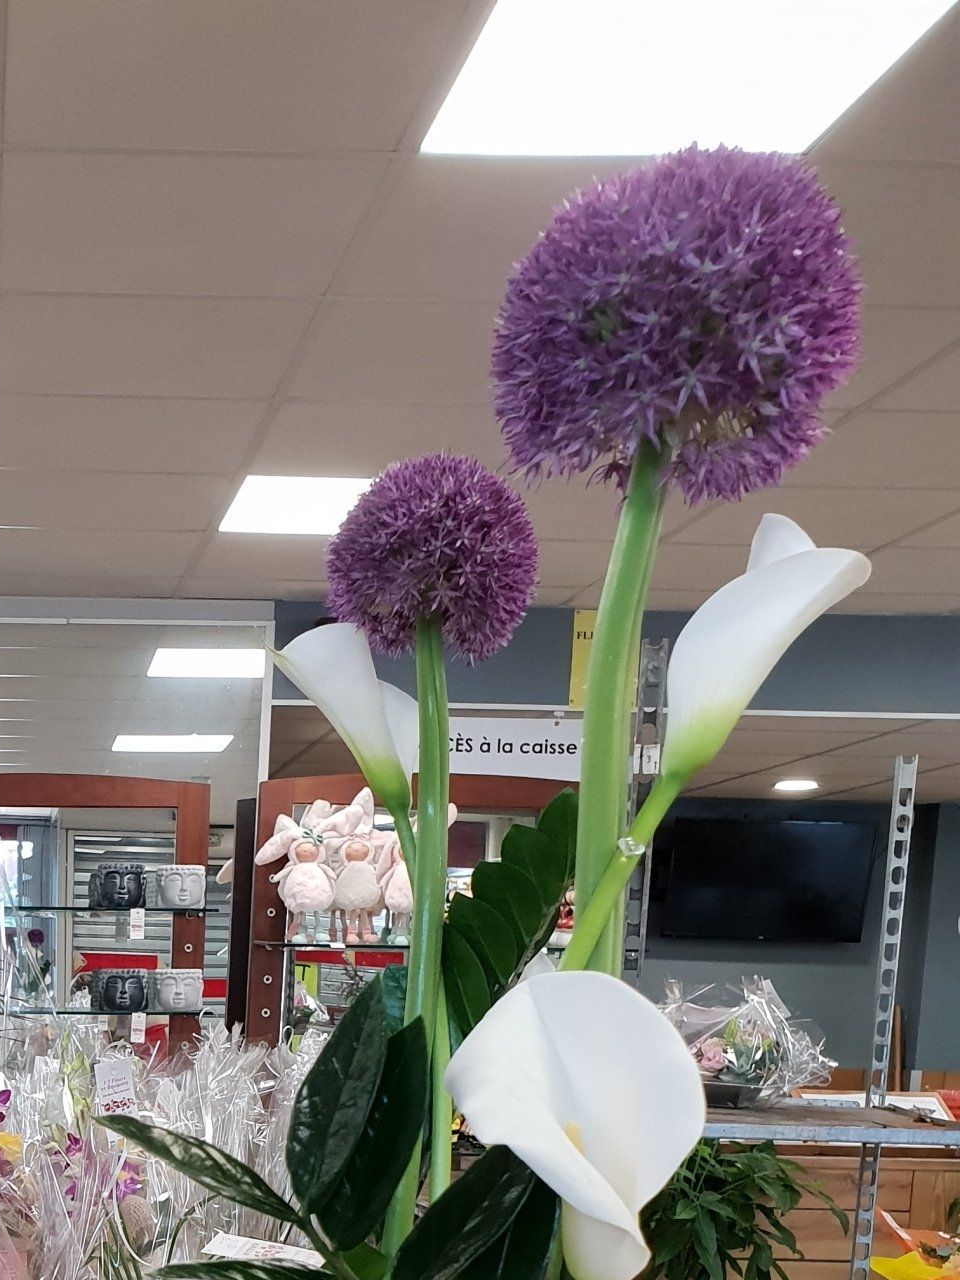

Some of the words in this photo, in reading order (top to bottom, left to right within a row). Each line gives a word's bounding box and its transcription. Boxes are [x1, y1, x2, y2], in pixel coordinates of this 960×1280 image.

[479, 736, 491, 753] à
[497, 738, 513, 754] la
[520, 739, 577, 754] caisse
